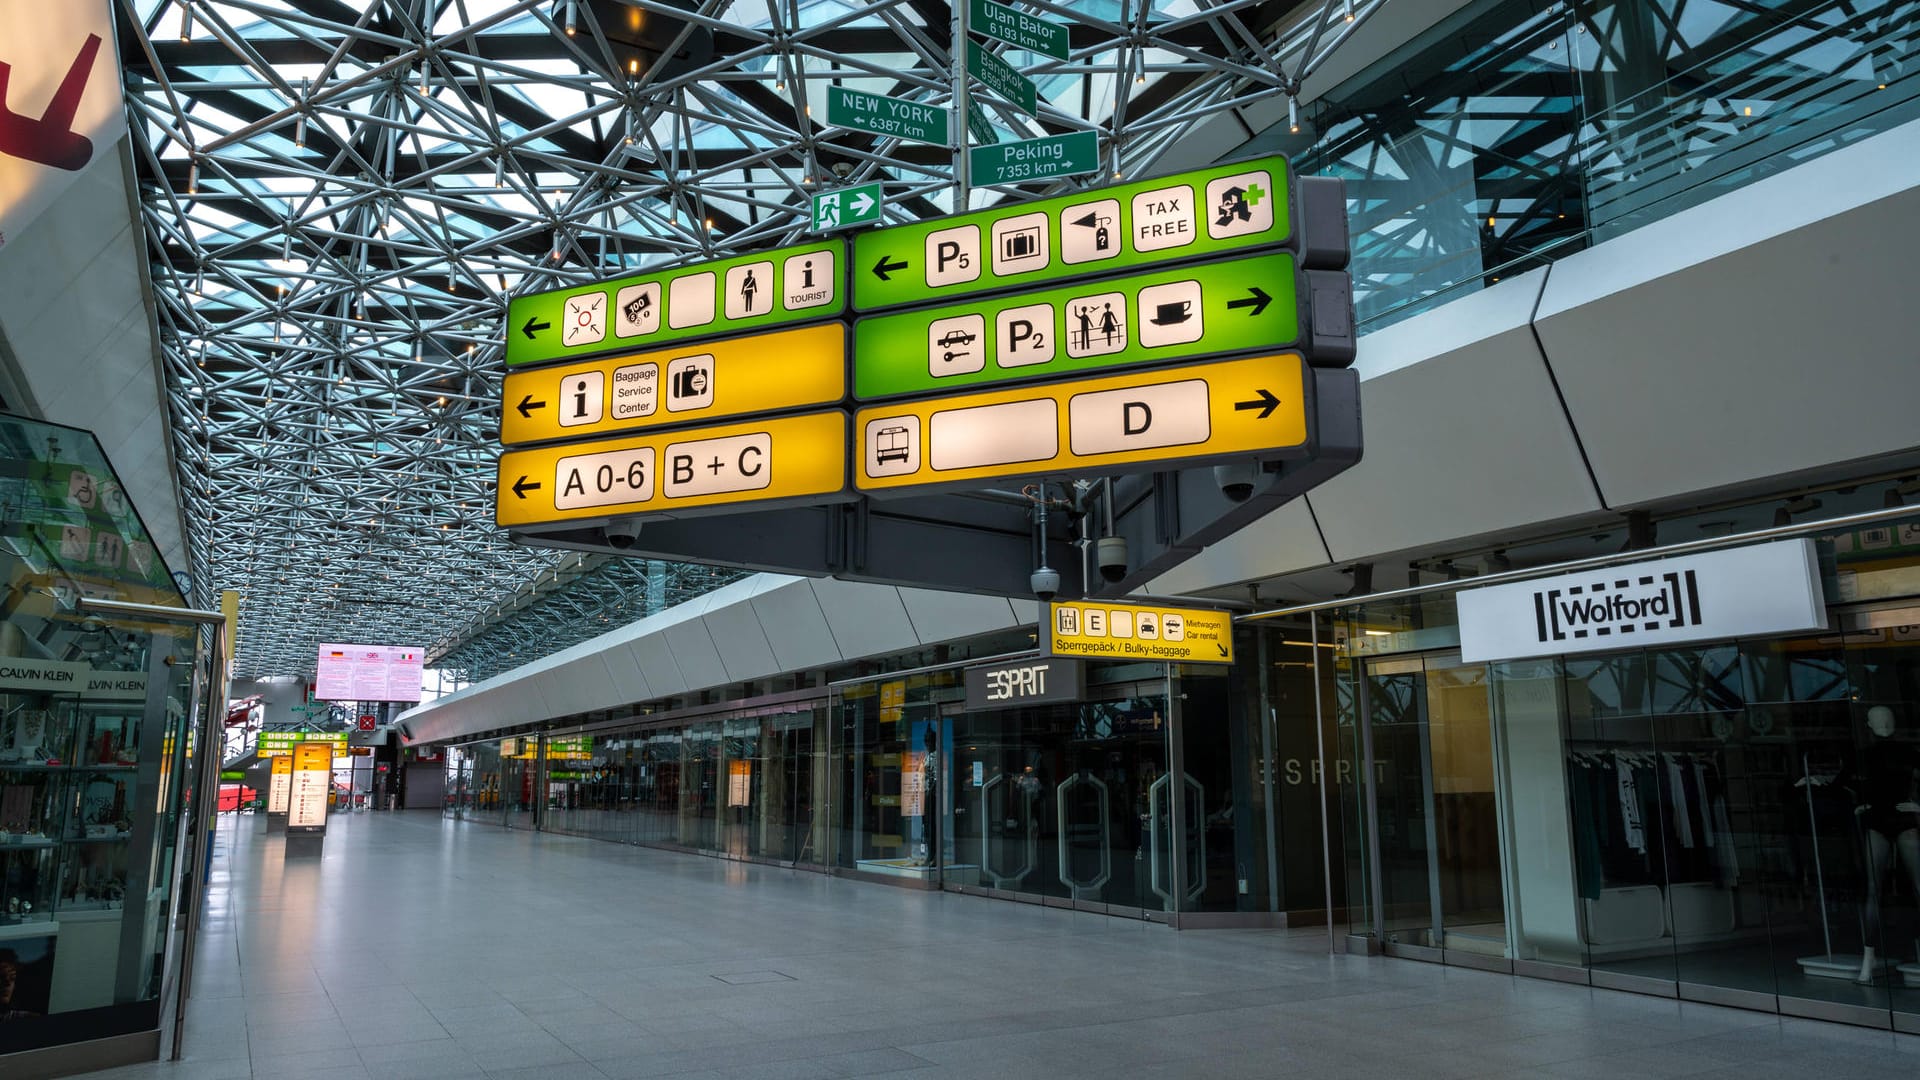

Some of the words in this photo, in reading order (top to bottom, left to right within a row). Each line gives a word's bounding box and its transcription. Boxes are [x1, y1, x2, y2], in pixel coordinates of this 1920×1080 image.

[984, 3, 1015, 27] Ulan
[1019, 16, 1056, 39] Bator
[1020, 32, 1038, 48] km
[981, 52, 1024, 92] Bangkok
[1002, 84, 1016, 100] km
[842, 93, 879, 113] NEW
[887, 102, 935, 125] YORK
[869, 118, 901, 132] 6387
[903, 124, 925, 138] km
[1004, 141, 1064, 162] Peking
[1034, 161, 1058, 175] km
[1145, 198, 1180, 216] TAX
[1141, 219, 1188, 240] FREE
[937, 241, 969, 273] P5
[629, 298, 645, 313] 100
[790, 291, 827, 304] TOURIST
[1009, 319, 1044, 353] P2
[615, 369, 656, 382] Baggage
[618, 386, 652, 398] Service
[619, 402, 650, 414] Center
[1123, 402, 1152, 436] D
[672, 454, 694, 485] B
[707, 456, 725, 475] +
[738, 445, 762, 477] C
[563, 468, 585, 497] A
[596, 460, 645, 493] 0-6
[1560, 587, 1670, 626] Wolford
[1091, 615, 1101, 630] E
[1185, 619, 1221, 631] Mietwagen
[1186, 631, 1199, 640] Car
[1200, 632, 1218, 641] rental
[1056, 639, 1116, 653] Sperrgepäck
[1117, 642, 1123, 652] /
[1124, 642, 1191, 658] Bulky-baggage
[0, 667, 41, 679] CALVIN
[43, 670, 74, 682] KLEIN
[986, 664, 1049, 700] ESPRIT
[88, 679, 113, 690] LVIN
[115, 680, 145, 691] KLEIN
